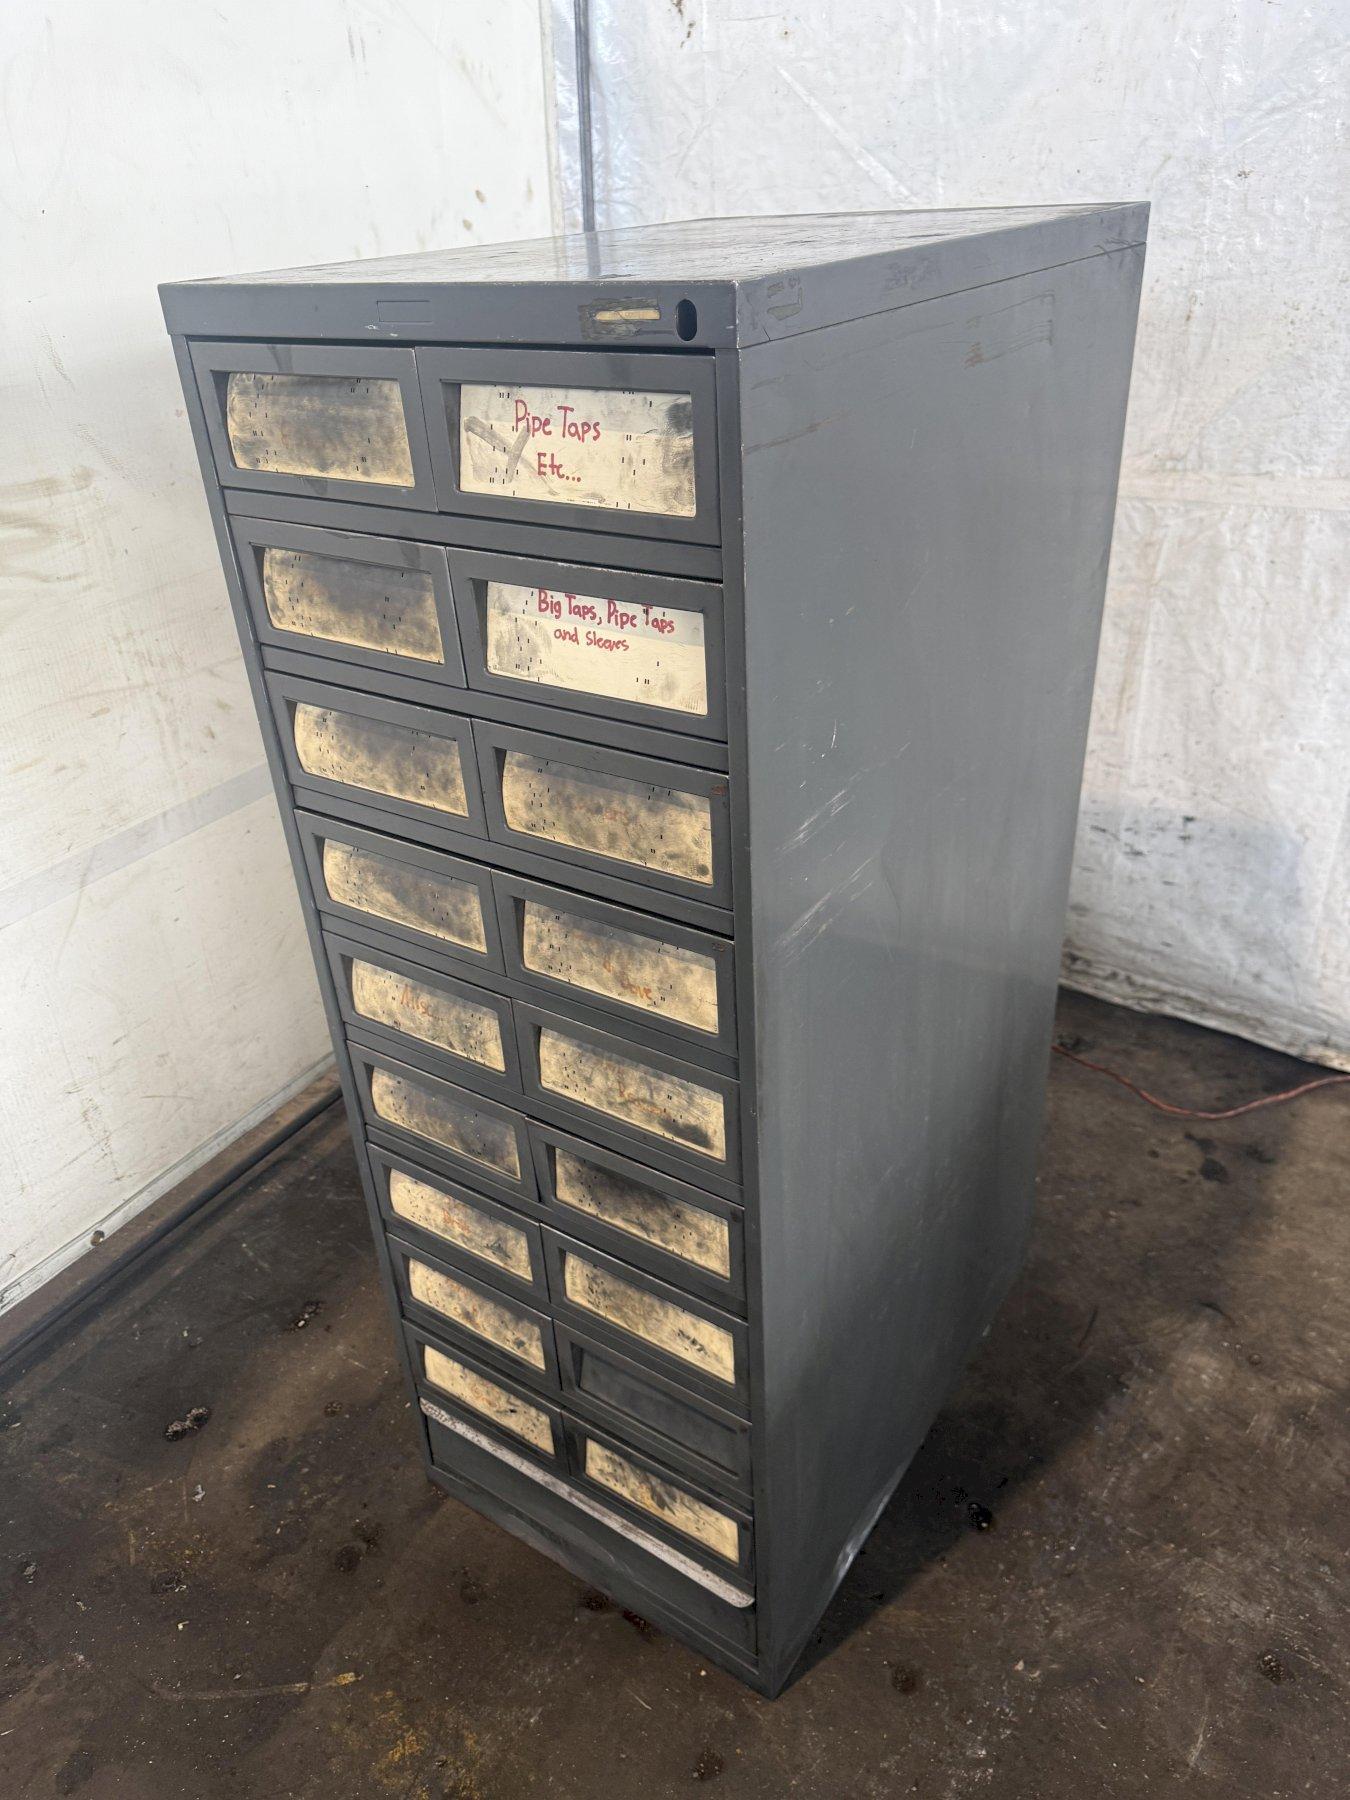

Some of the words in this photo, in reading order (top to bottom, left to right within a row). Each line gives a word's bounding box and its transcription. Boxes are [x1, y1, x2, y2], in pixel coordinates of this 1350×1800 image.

[515, 399, 551, 437] Pipe
[557, 405, 601, 442] Taps
[537, 452, 582, 483] Etc...
[538, 588, 562, 619] Big
[565, 593, 603, 626] Taps,
[607, 600, 637, 629] Pipe
[641, 604, 675, 634] Taps
[554, 627, 579, 646] and
